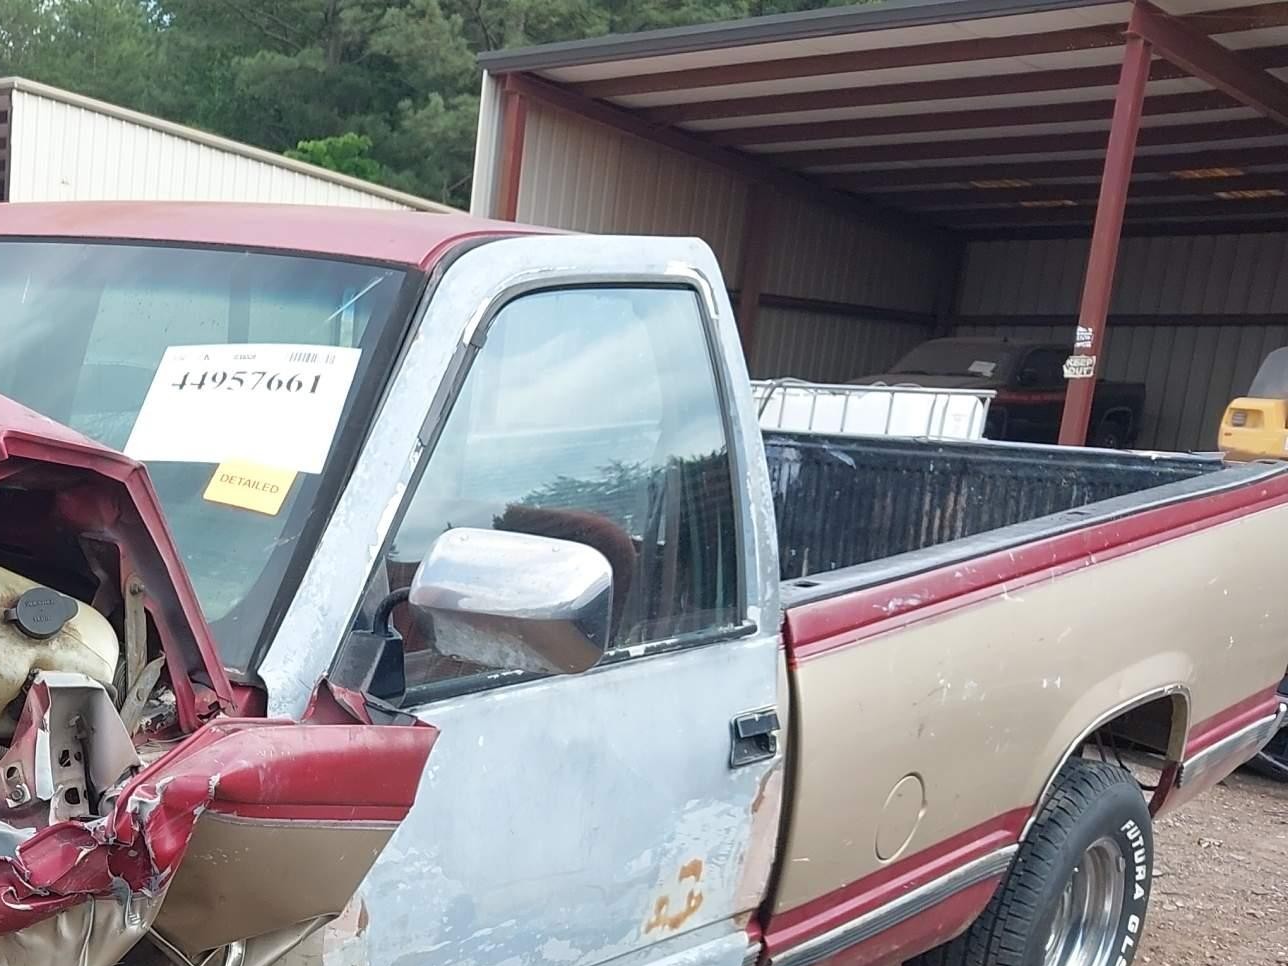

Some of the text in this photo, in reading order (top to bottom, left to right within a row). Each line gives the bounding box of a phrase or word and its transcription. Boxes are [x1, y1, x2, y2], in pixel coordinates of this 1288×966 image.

[1066, 358, 1093, 366] KEEP
[1068, 366, 1092, 375] OUT
[171, 371, 321, 393] 44957661
[219, 473, 280, 495] DETAILED
[1120, 819, 1147, 900] FUTURA
